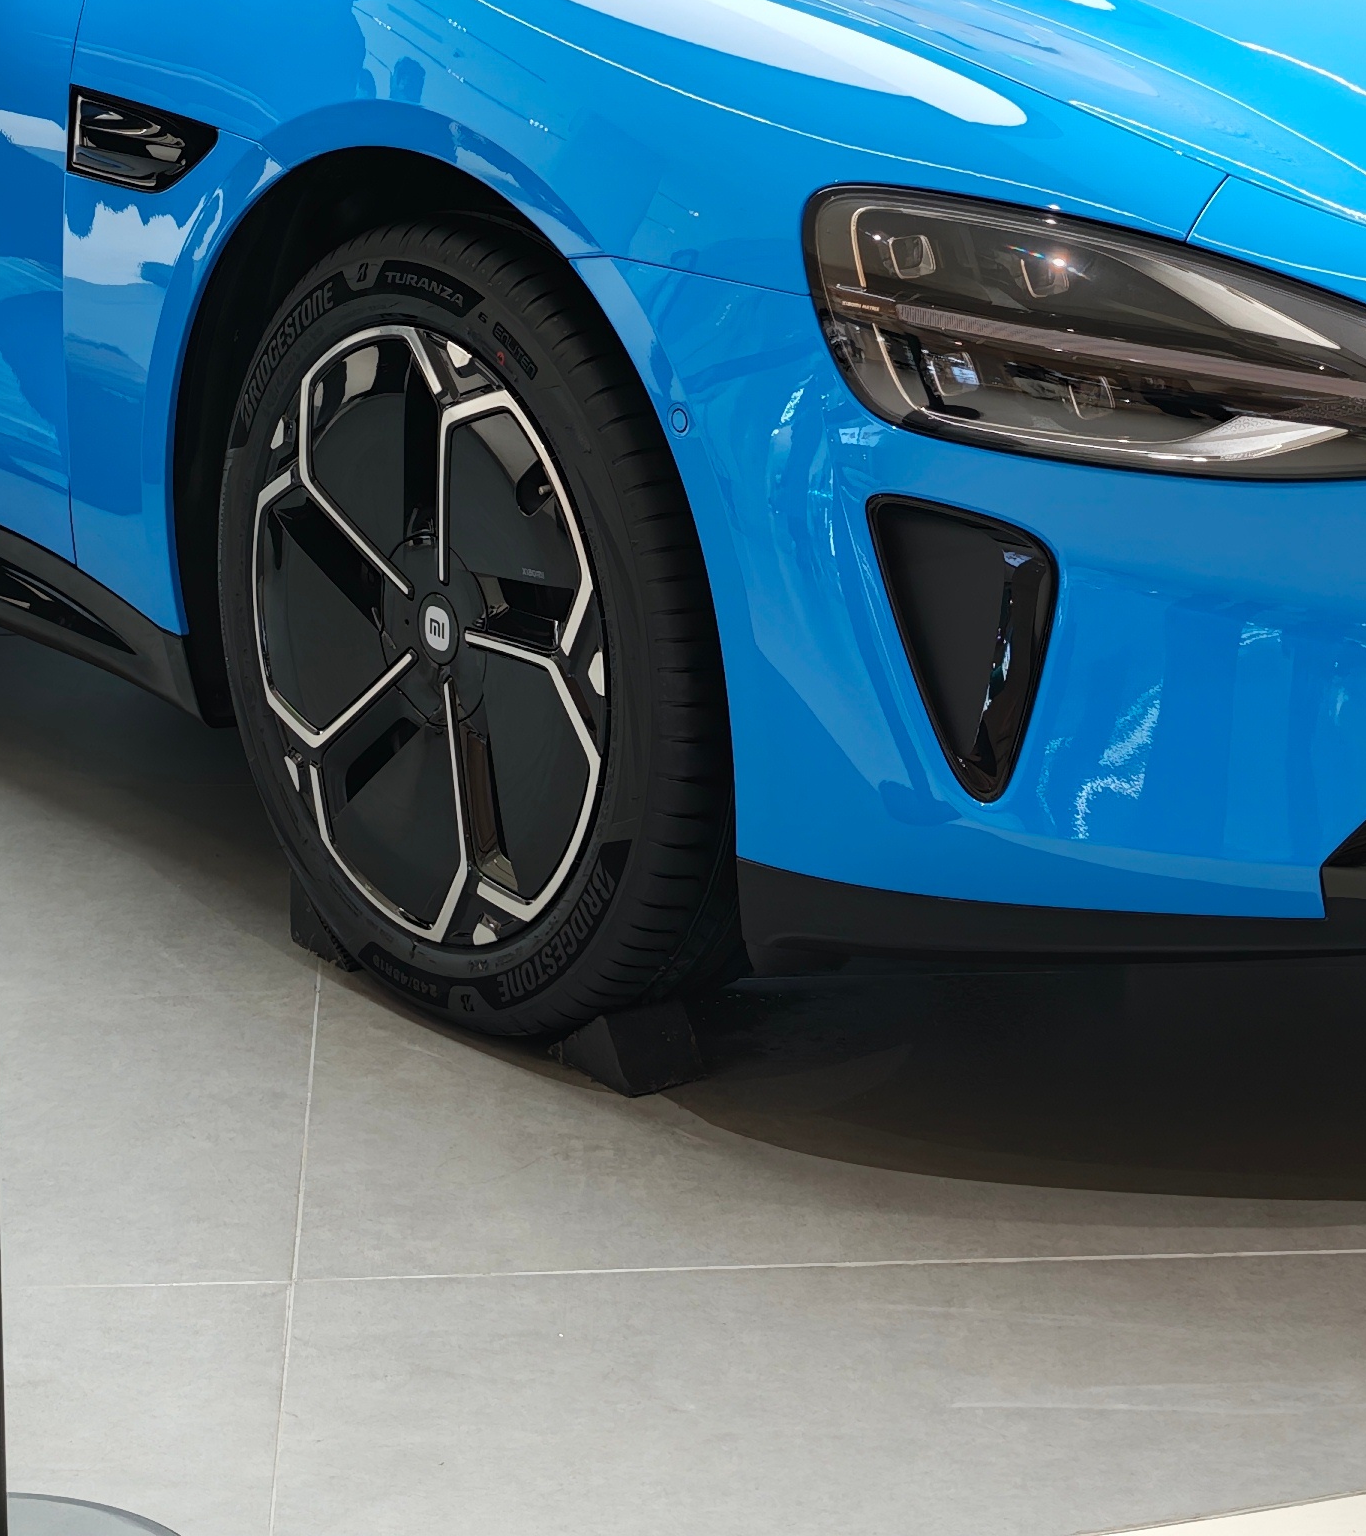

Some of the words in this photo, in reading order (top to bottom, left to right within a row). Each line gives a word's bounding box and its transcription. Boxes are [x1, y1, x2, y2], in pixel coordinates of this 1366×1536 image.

[240, 282, 335, 433] BRIDGESTONE
[383, 270, 464, 308] TURANZA
[496, 855, 617, 1003] BRIDGESTONE
